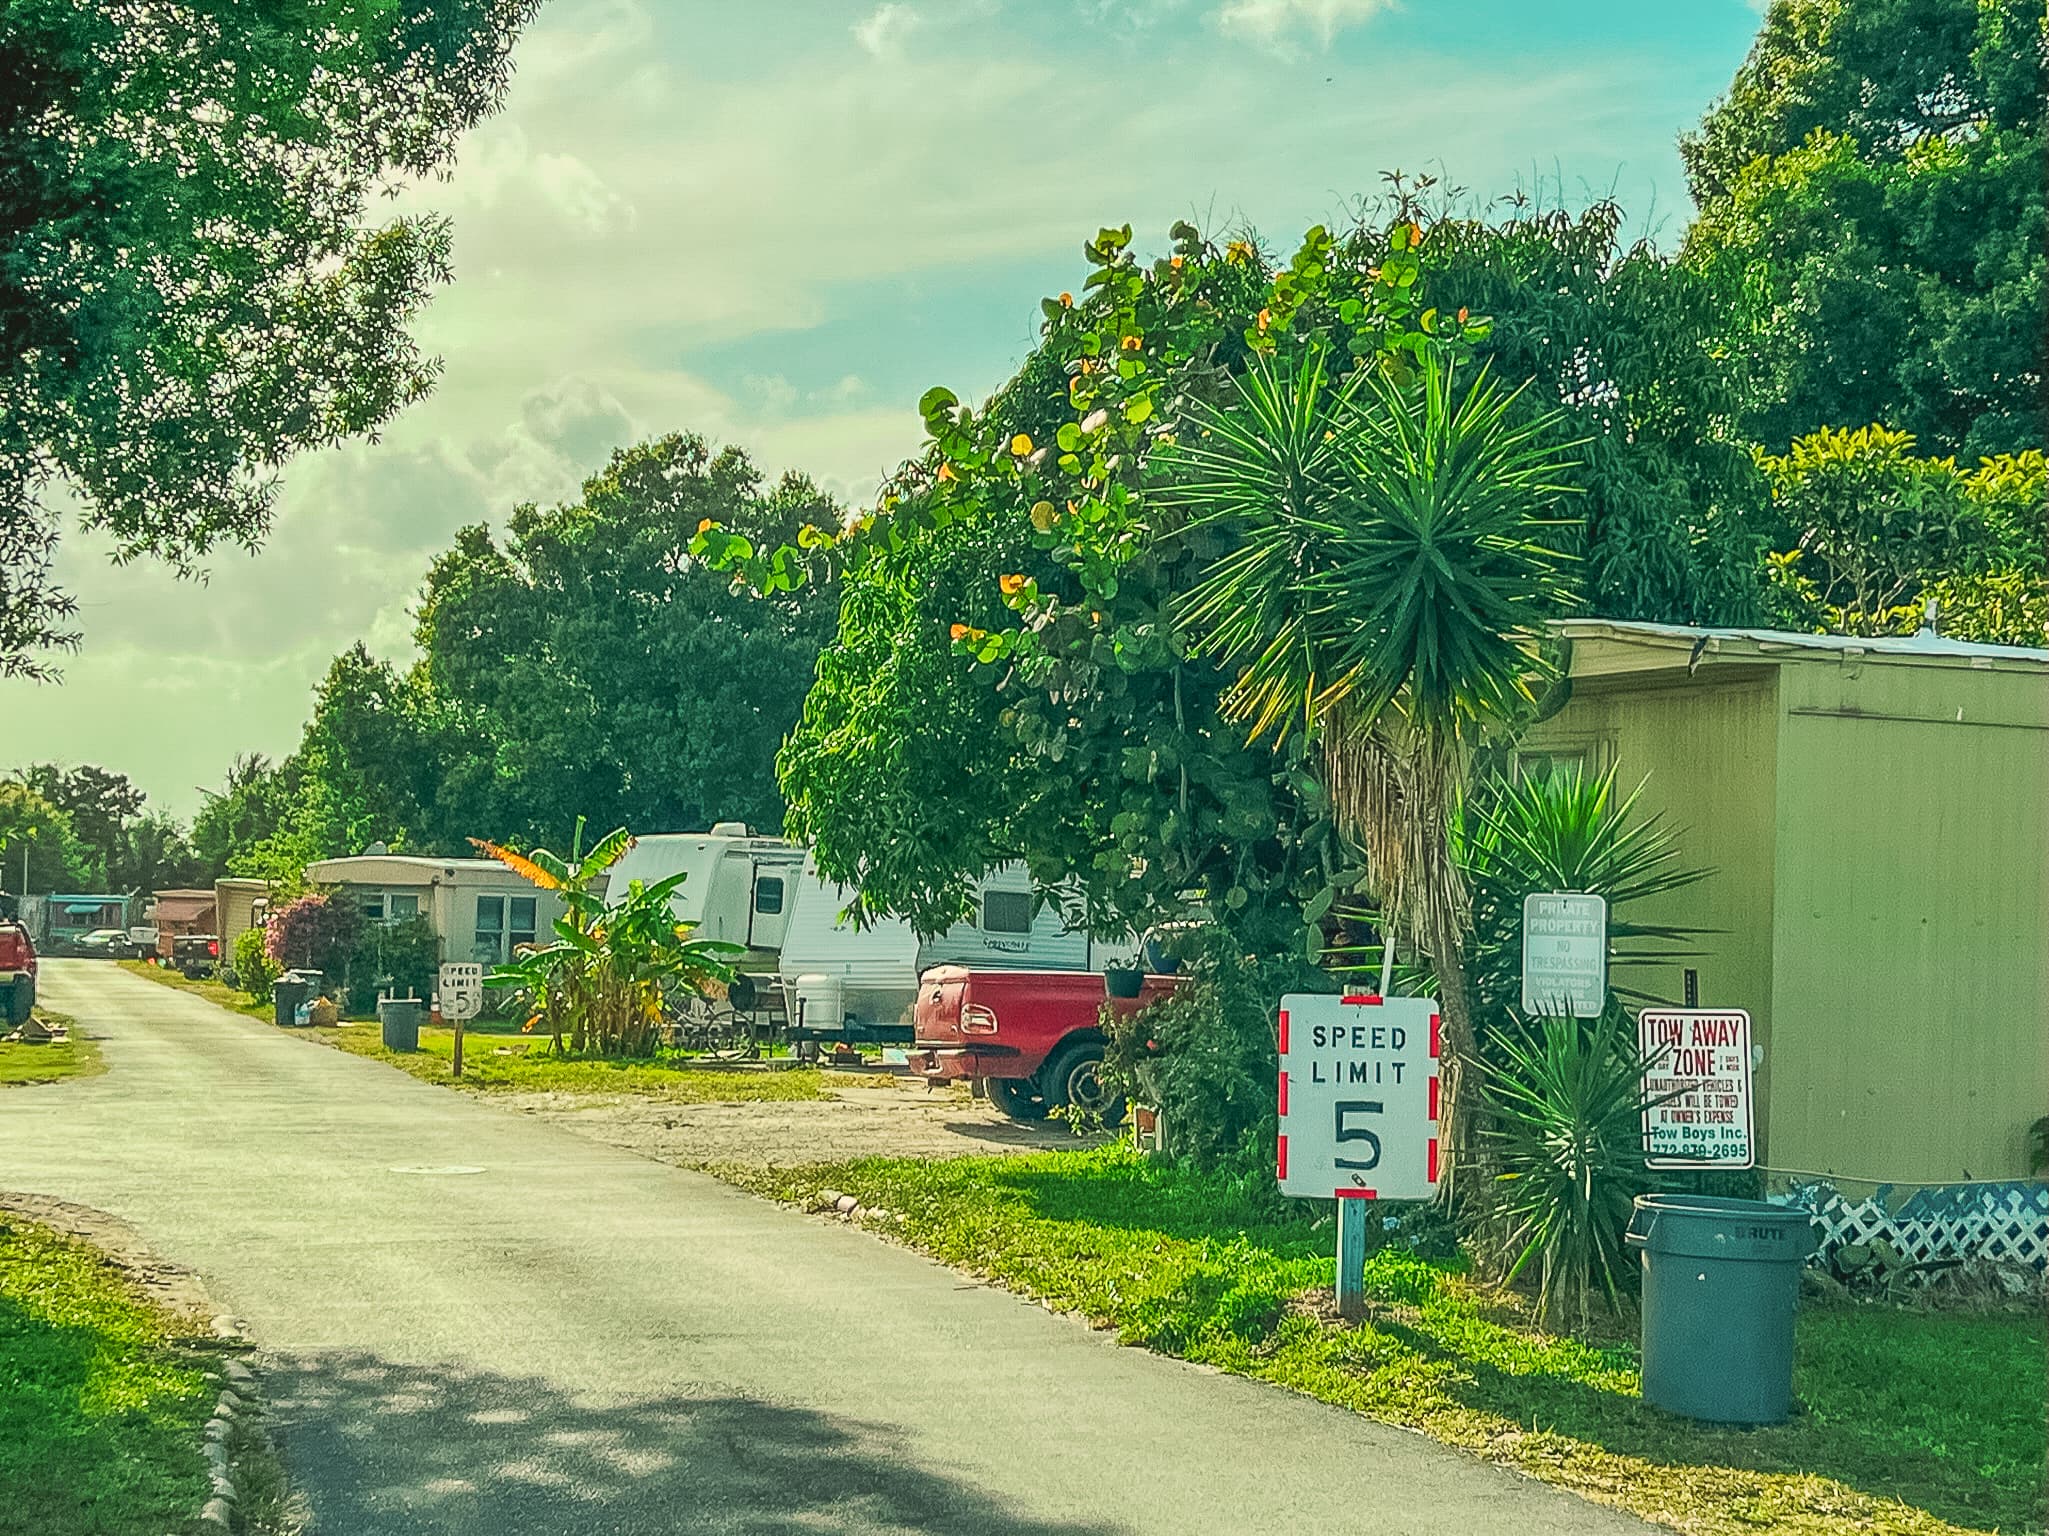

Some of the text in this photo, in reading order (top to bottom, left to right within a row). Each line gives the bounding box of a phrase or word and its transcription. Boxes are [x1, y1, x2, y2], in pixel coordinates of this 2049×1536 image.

[1539, 901, 1591, 917] PRIVATE
[1530, 918, 1600, 934] PROPERTY
[1556, 940, 1570, 953] NO
[1531, 956, 1597, 970] TRESPASSING
[442, 978, 476, 987] LIMIT
[456, 991, 470, 1013] 5
[1312, 1026, 1406, 1051] SPEED
[1648, 1019, 1739, 1047] TOW AWAY
[1673, 1048, 1715, 1076] ZONE
[1312, 1061, 1406, 1083] LIMIT
[1685, 1095, 1701, 1108] WILL
[1704, 1095, 1713, 1108] BE
[1715, 1095, 1738, 1108] TOWED
[1661, 1110, 1667, 1123] AT
[1704, 1110, 1734, 1124] EXPENSE
[1335, 1101, 1383, 1170] 5
[1651, 1126, 1747, 1141] Tow Boys Inc.
[1735, 1227, 1783, 1240] BRUTE
